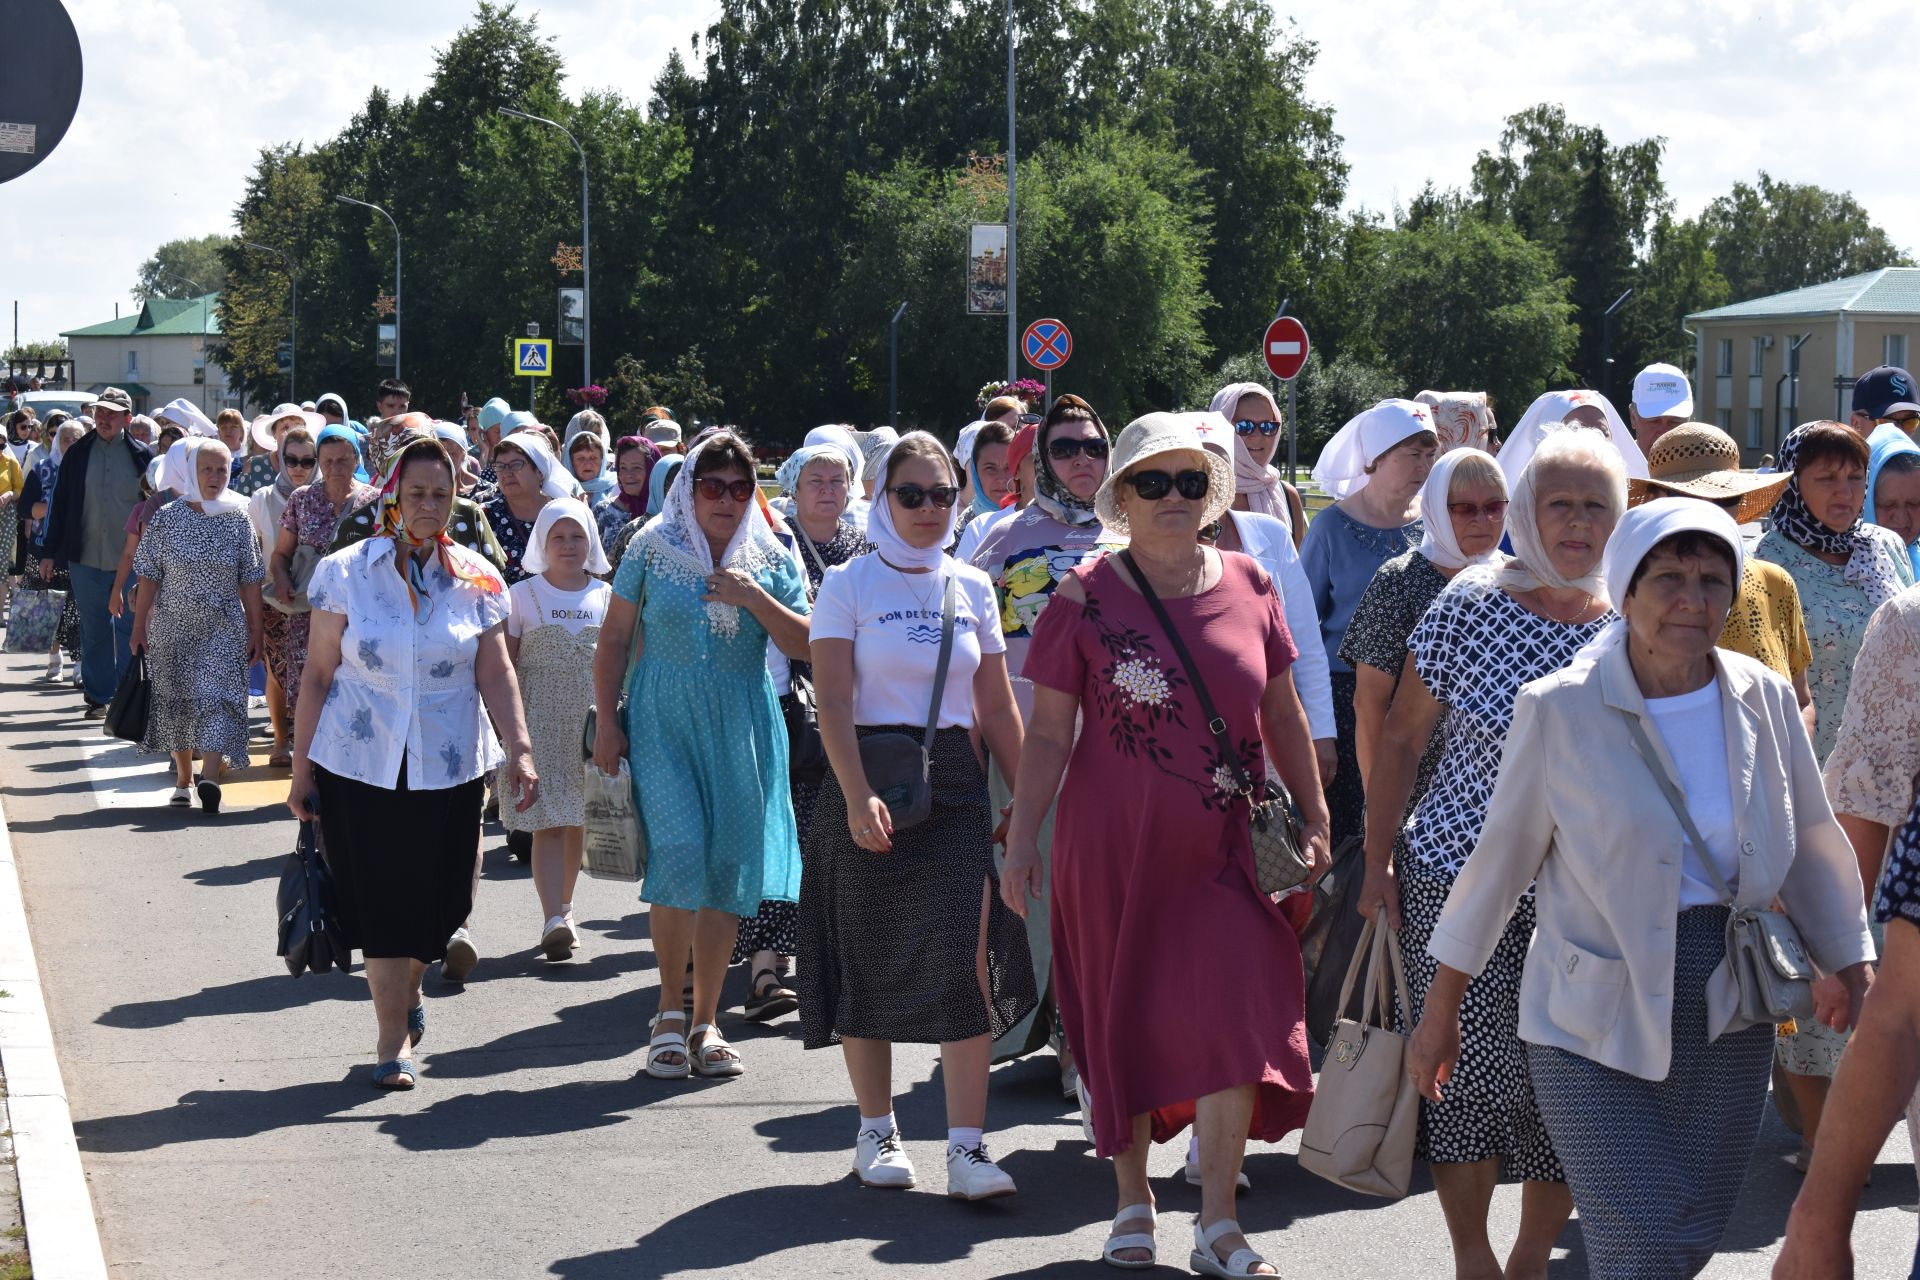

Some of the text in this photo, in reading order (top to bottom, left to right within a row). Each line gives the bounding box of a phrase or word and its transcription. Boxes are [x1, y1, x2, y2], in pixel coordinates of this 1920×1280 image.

[878, 610, 969, 627] SON DE L'OAN
